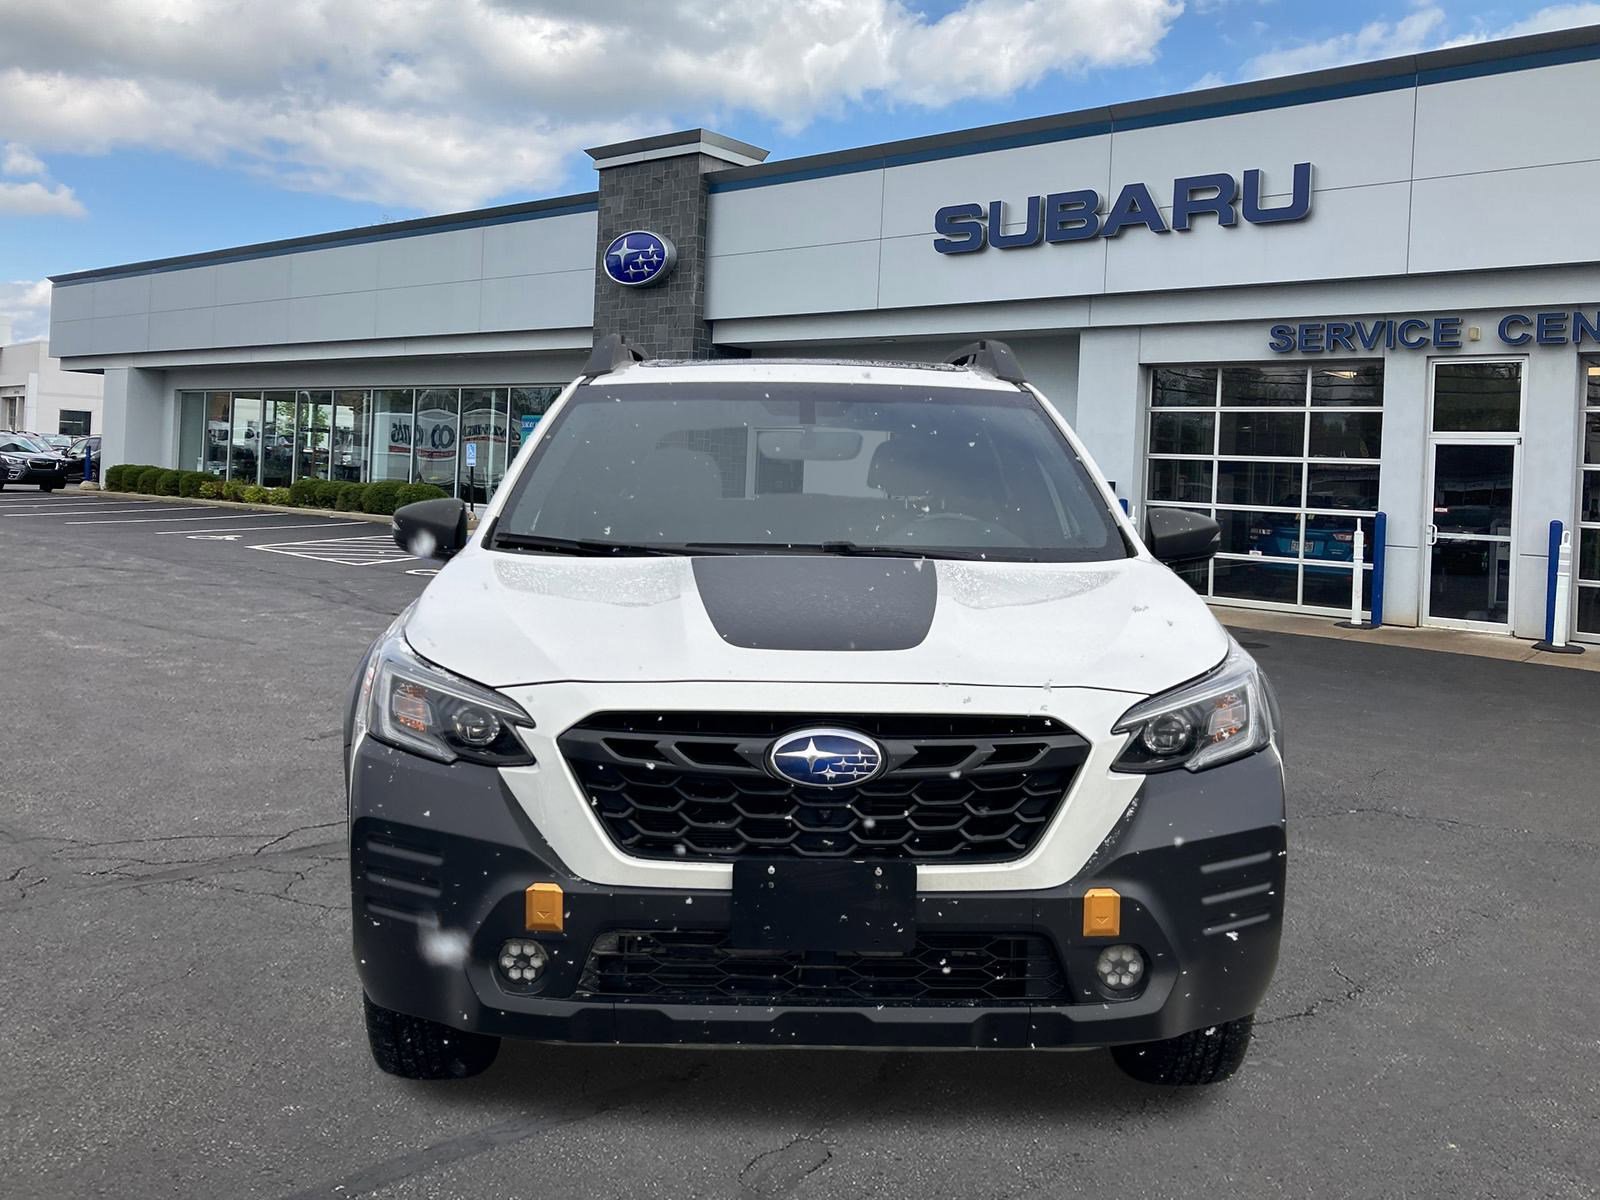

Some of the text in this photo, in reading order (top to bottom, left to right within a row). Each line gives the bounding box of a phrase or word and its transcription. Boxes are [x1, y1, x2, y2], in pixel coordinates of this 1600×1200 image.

[933, 162, 1313, 255] SUBARU
[1269, 311, 1600, 353] SERVICE CEN
